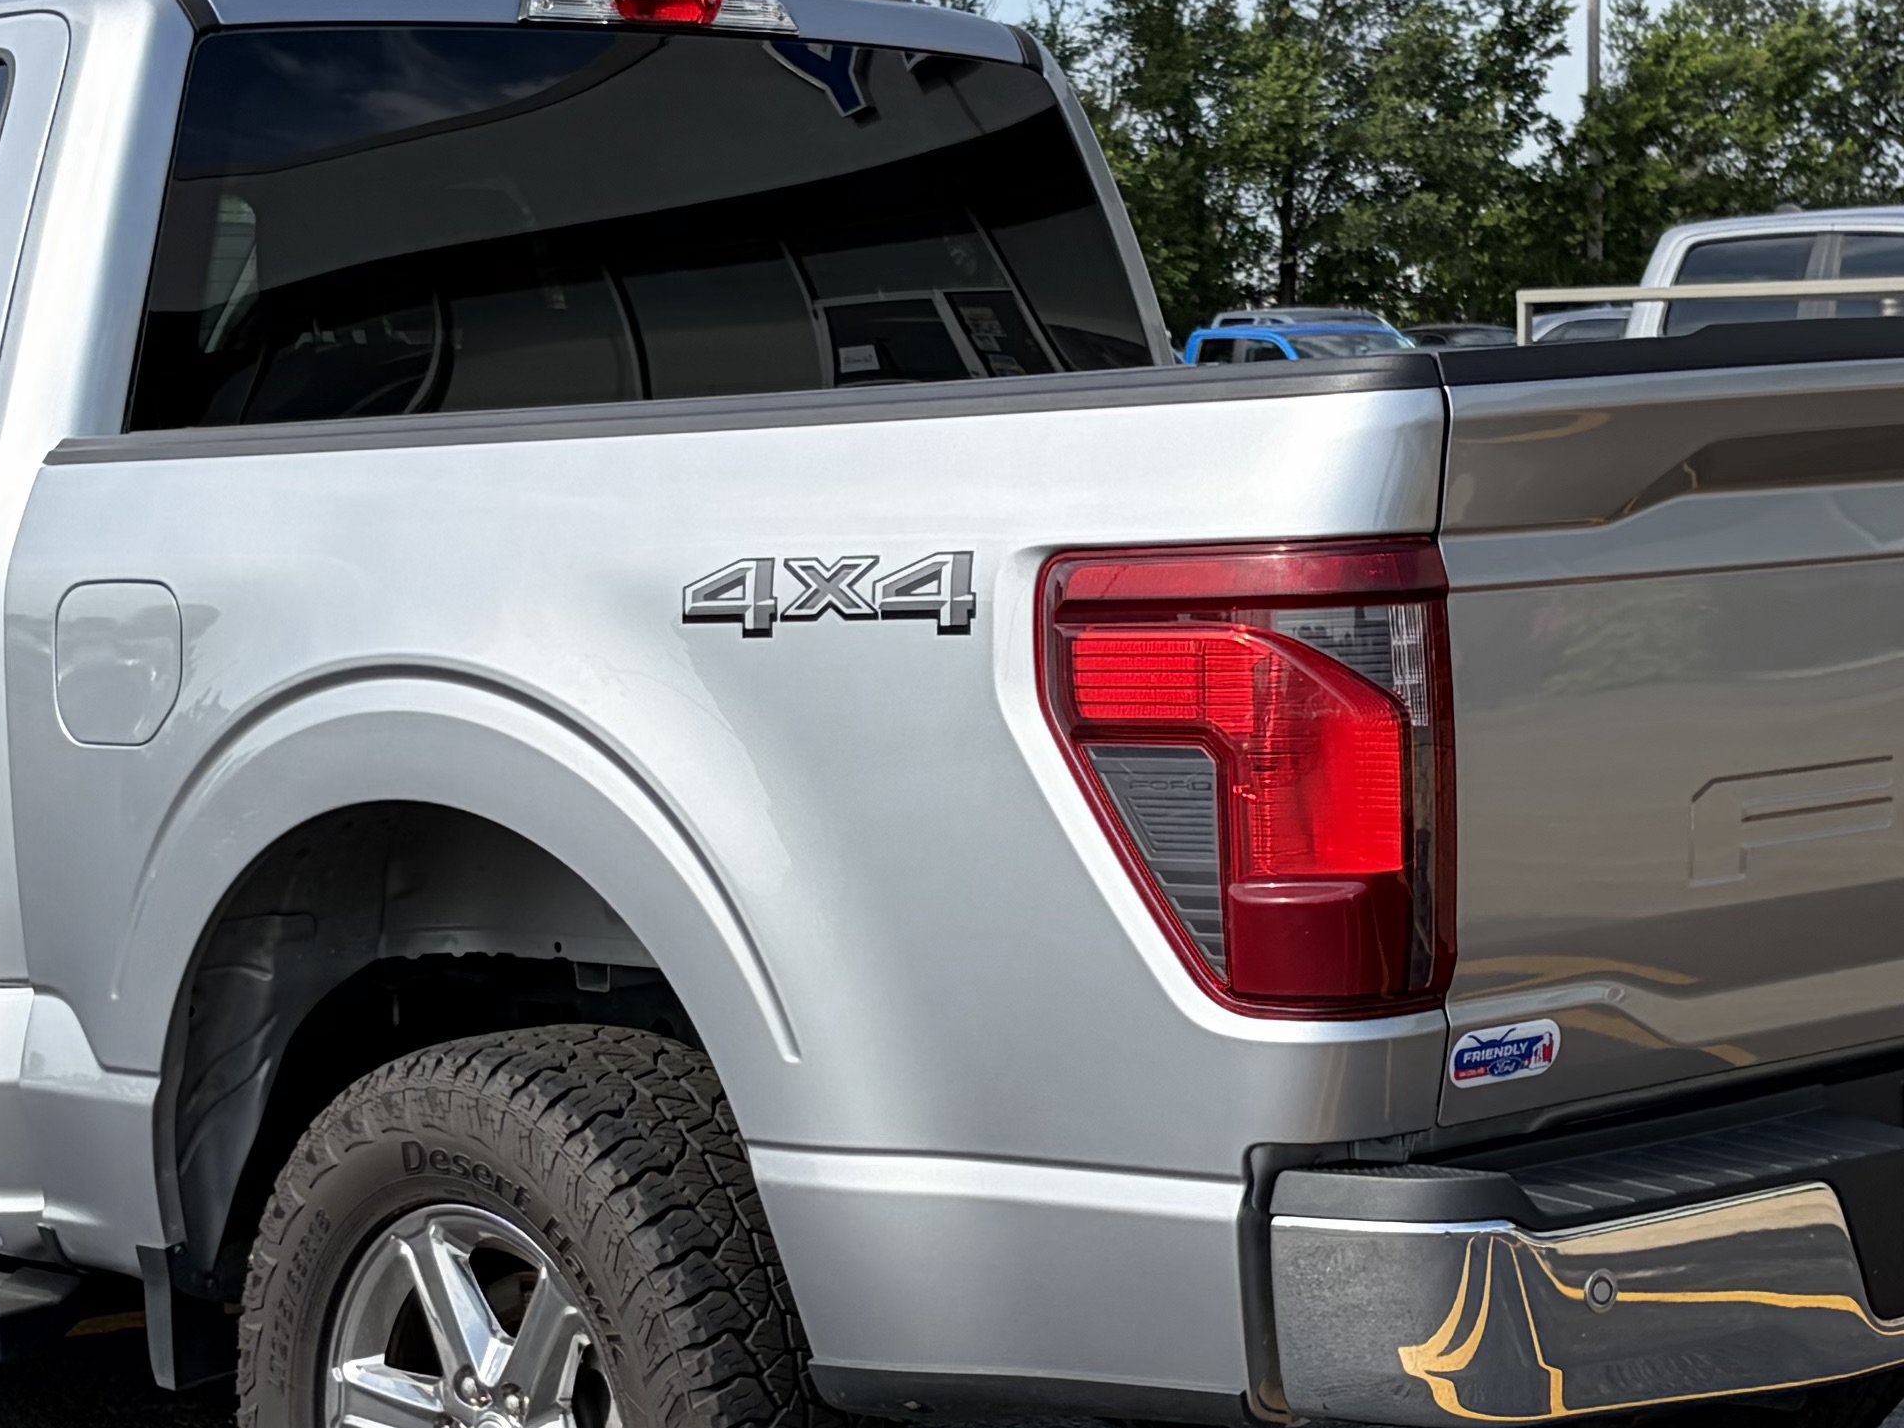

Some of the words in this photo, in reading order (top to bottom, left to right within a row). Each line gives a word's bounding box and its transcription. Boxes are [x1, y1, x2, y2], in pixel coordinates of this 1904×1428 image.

[1128, 780, 1212, 792] FORD
[1462, 1041, 1529, 1064] FRIENDLY
[401, 1139, 532, 1215] Desert
[543, 1214, 627, 1366] Hawk
